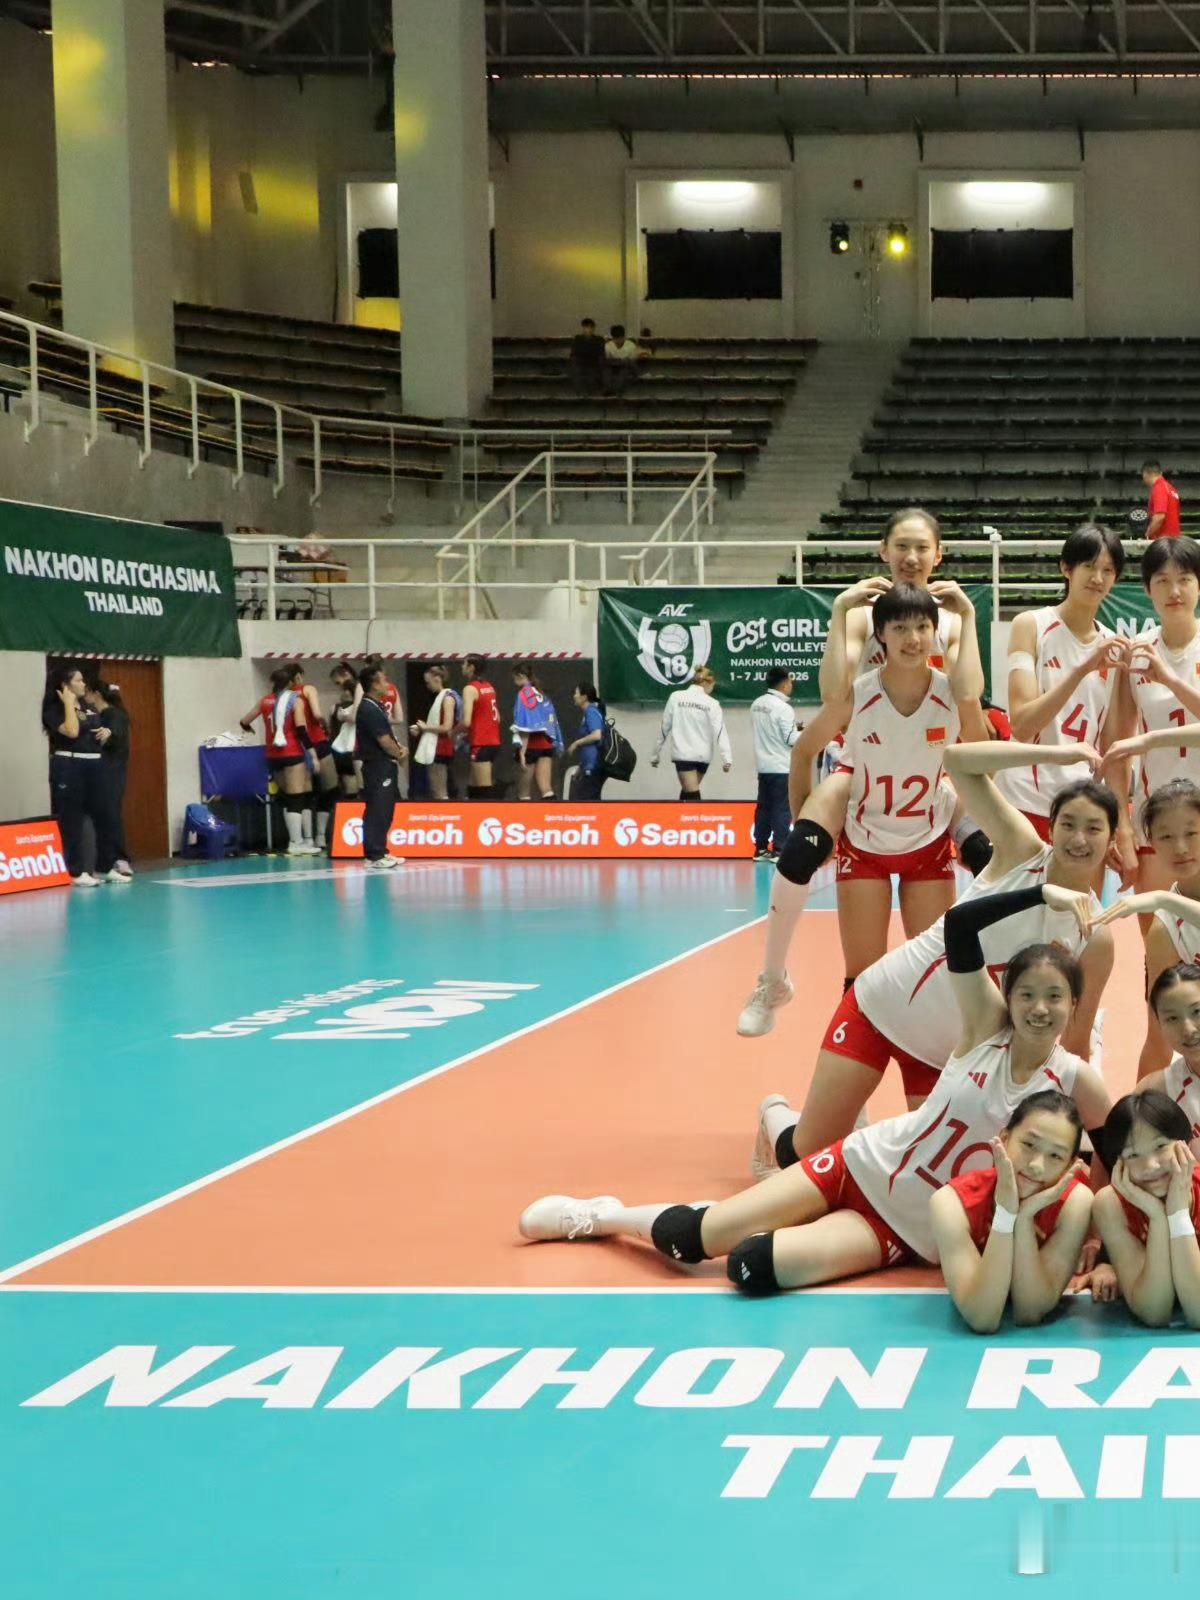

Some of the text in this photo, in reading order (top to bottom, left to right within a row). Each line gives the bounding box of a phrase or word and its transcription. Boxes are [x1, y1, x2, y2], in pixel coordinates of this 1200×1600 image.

[4, 545, 222, 594] NAKHON RATCHASIMA
[84, 590, 164, 616] THAILAND
[658, 603, 694, 617] AVC
[726, 617, 767, 653] est
[660, 654, 689, 679] 18
[730, 658, 773, 667] NAKHON
[730, 671, 735, 681] 1
[744, 671, 751, 681] 7
[788, 671, 809, 681] 026
[1061, 704, 1089, 742] 4
[1168, 708, 1187, 757] 1
[875, 774, 930, 818] 12
[389, 823, 463, 846] enoh
[504, 823, 599, 846] Senoh
[641, 823, 735, 846] Senoh
[0, 845, 68, 882] Senoh
[270, 980, 542, 1041] NOW
[832, 1021, 847, 1044] 6
[809, 1149, 836, 1174] 10
[22, 1346, 929, 1409] NAKHON
